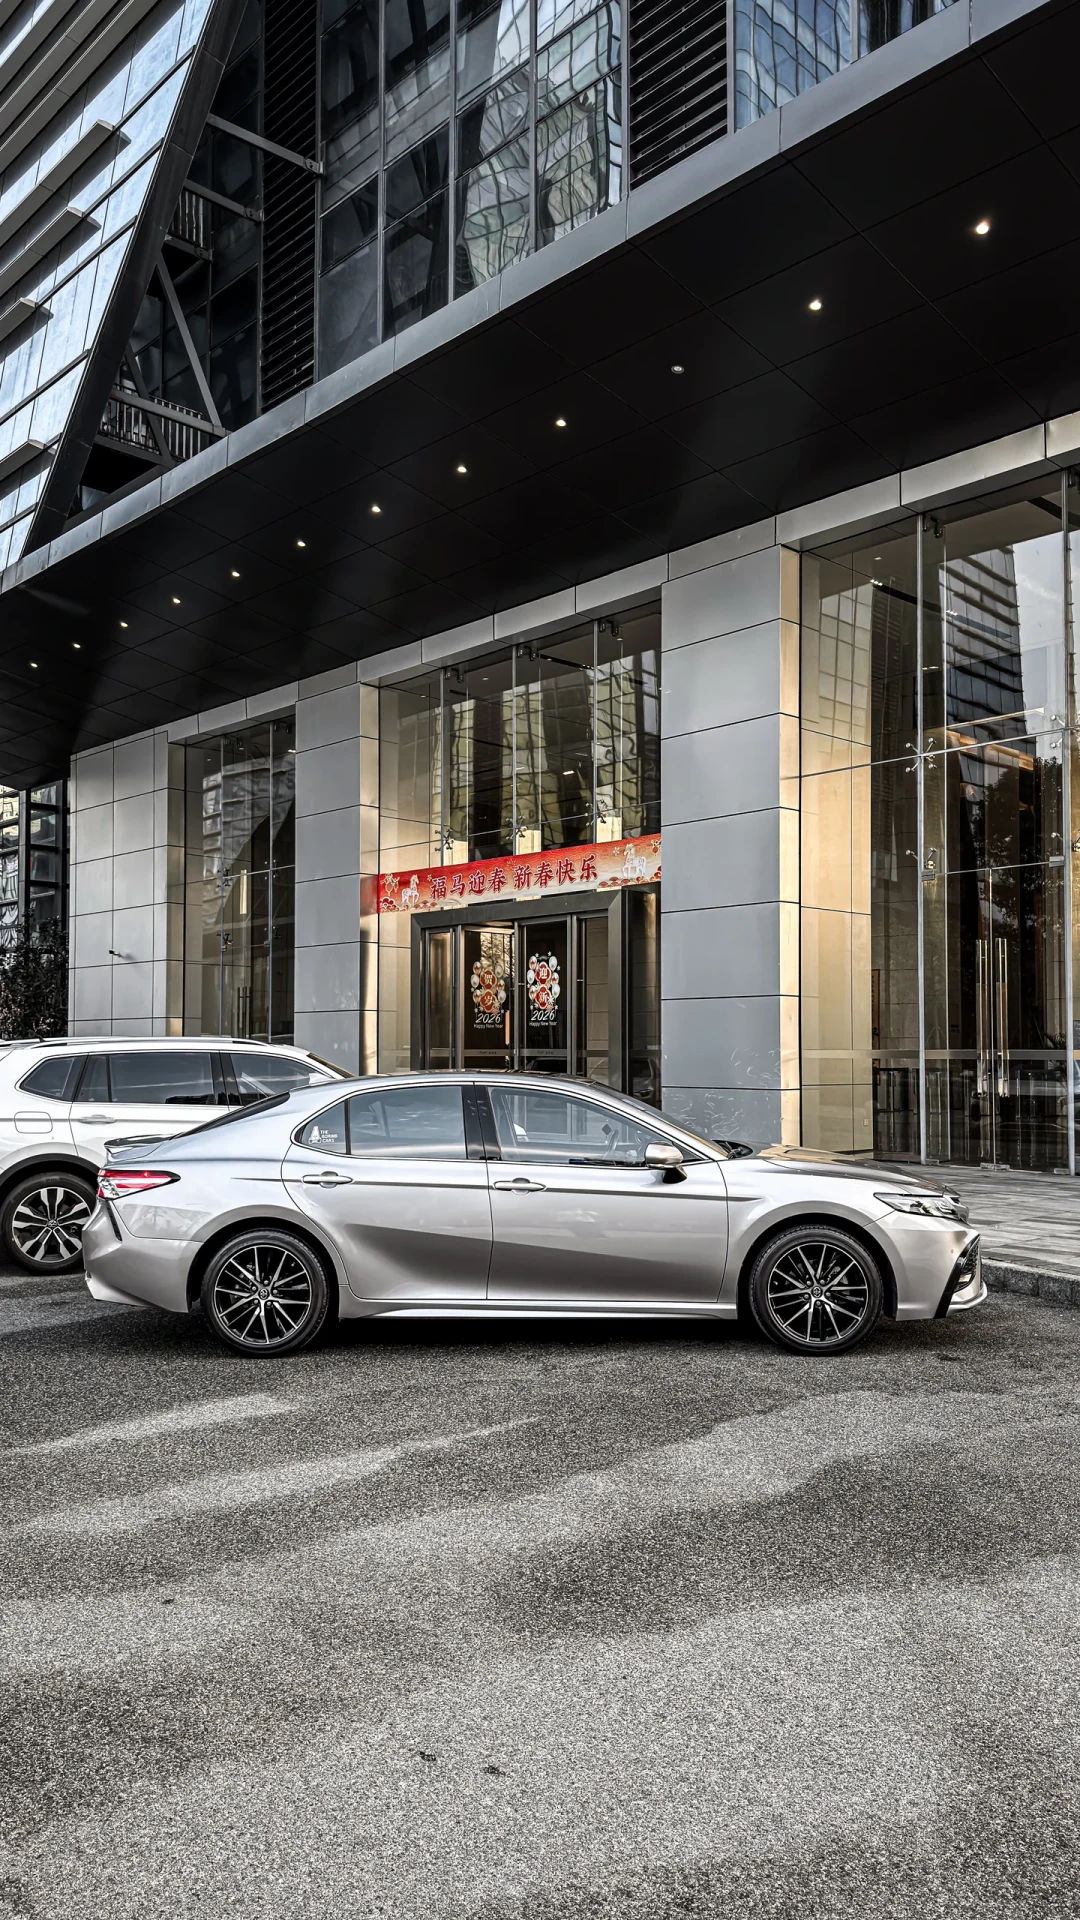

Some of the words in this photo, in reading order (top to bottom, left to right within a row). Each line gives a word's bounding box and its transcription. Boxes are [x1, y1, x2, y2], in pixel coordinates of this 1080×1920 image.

[430, 867, 507, 900] 福马迎春
[514, 853, 599, 889] 新春快乐
[475, 1013, 501, 1023] 2026
[531, 1010, 555, 1020] 2026
